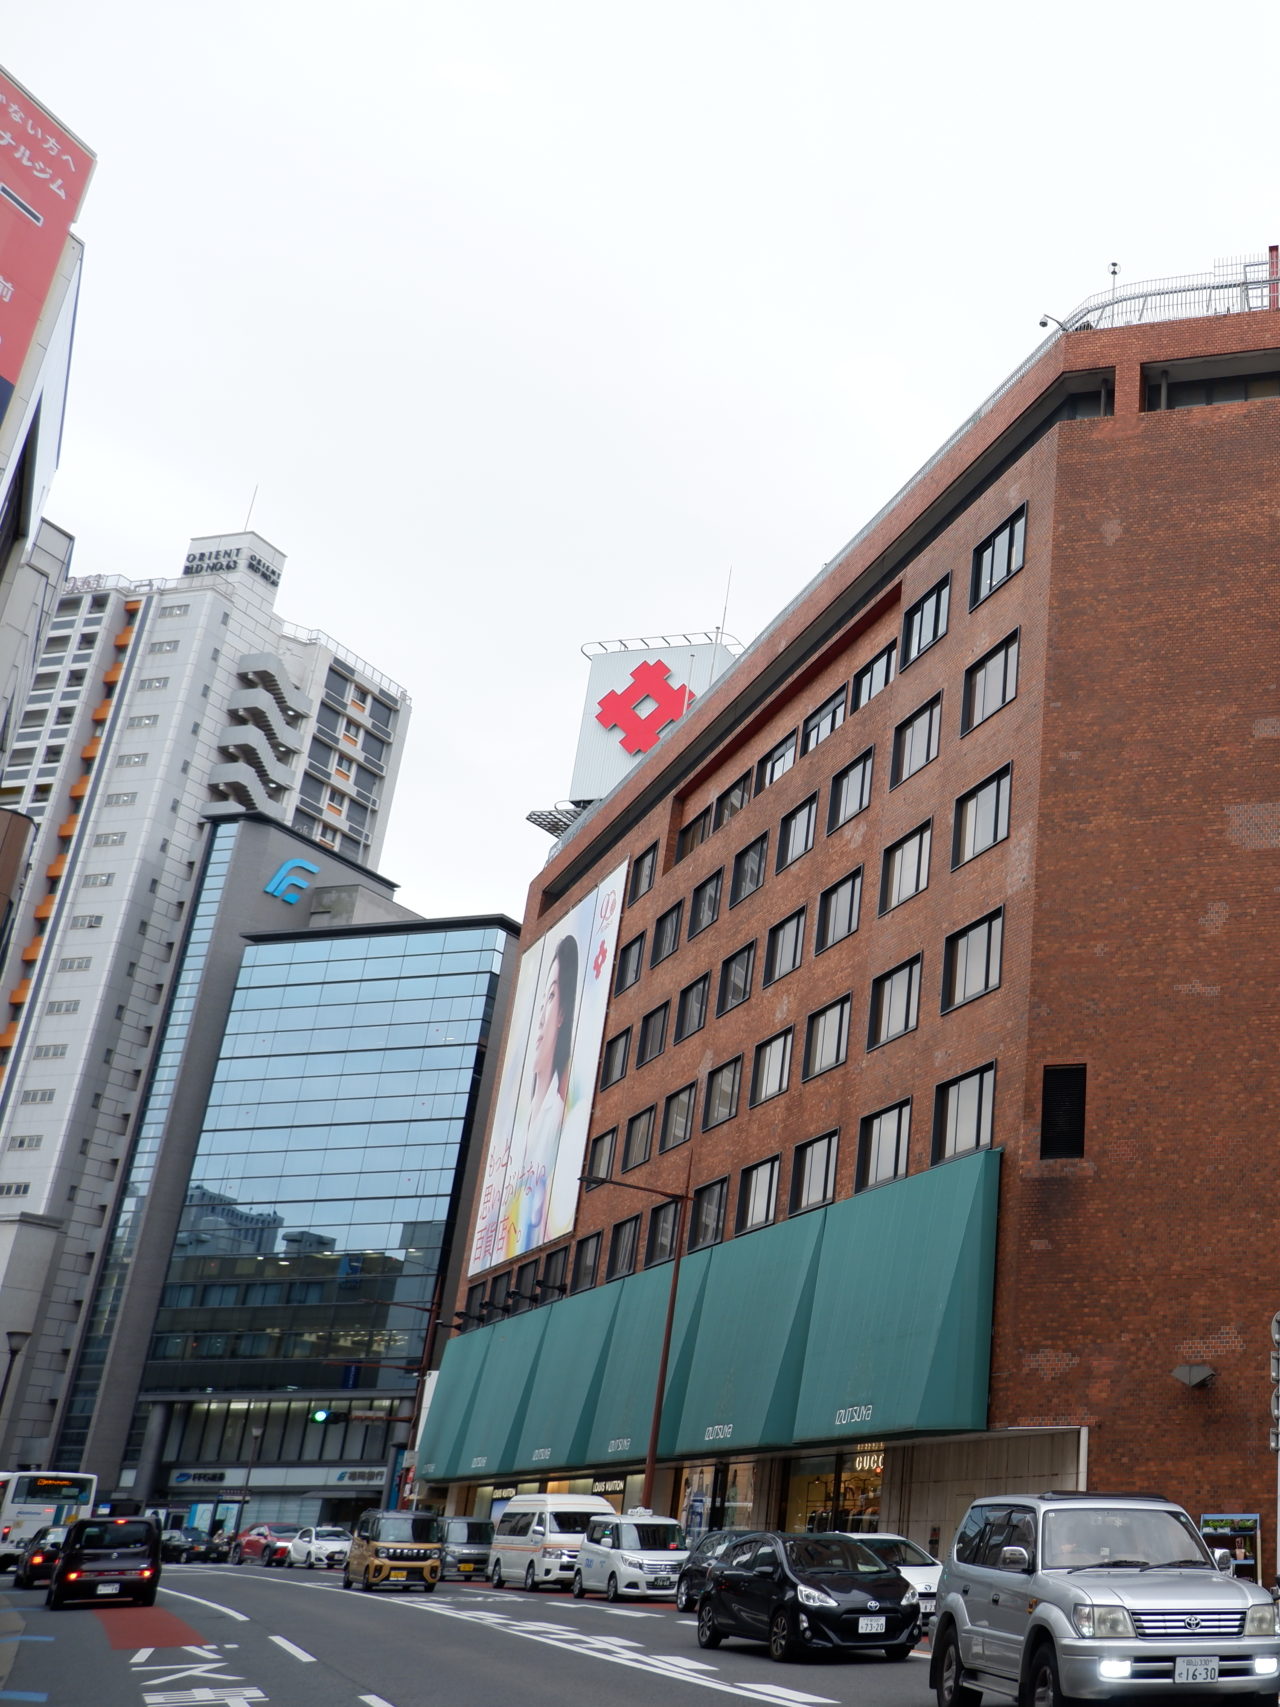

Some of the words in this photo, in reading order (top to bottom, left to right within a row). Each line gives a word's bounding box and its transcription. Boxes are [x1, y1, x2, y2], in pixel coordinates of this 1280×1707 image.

[186, 548, 242, 563] ORIENT
[480, 1161, 546, 1220] 思いがけない
[835, 1404, 873, 1425] IZUTSUYA
[704, 1423, 733, 1441] IZUTSUYA
[855, 1454, 885, 1470] GUCC
[592, 1481, 606, 1492] LOUIS
[1185, 1667, 1216, 1681] 16-30
